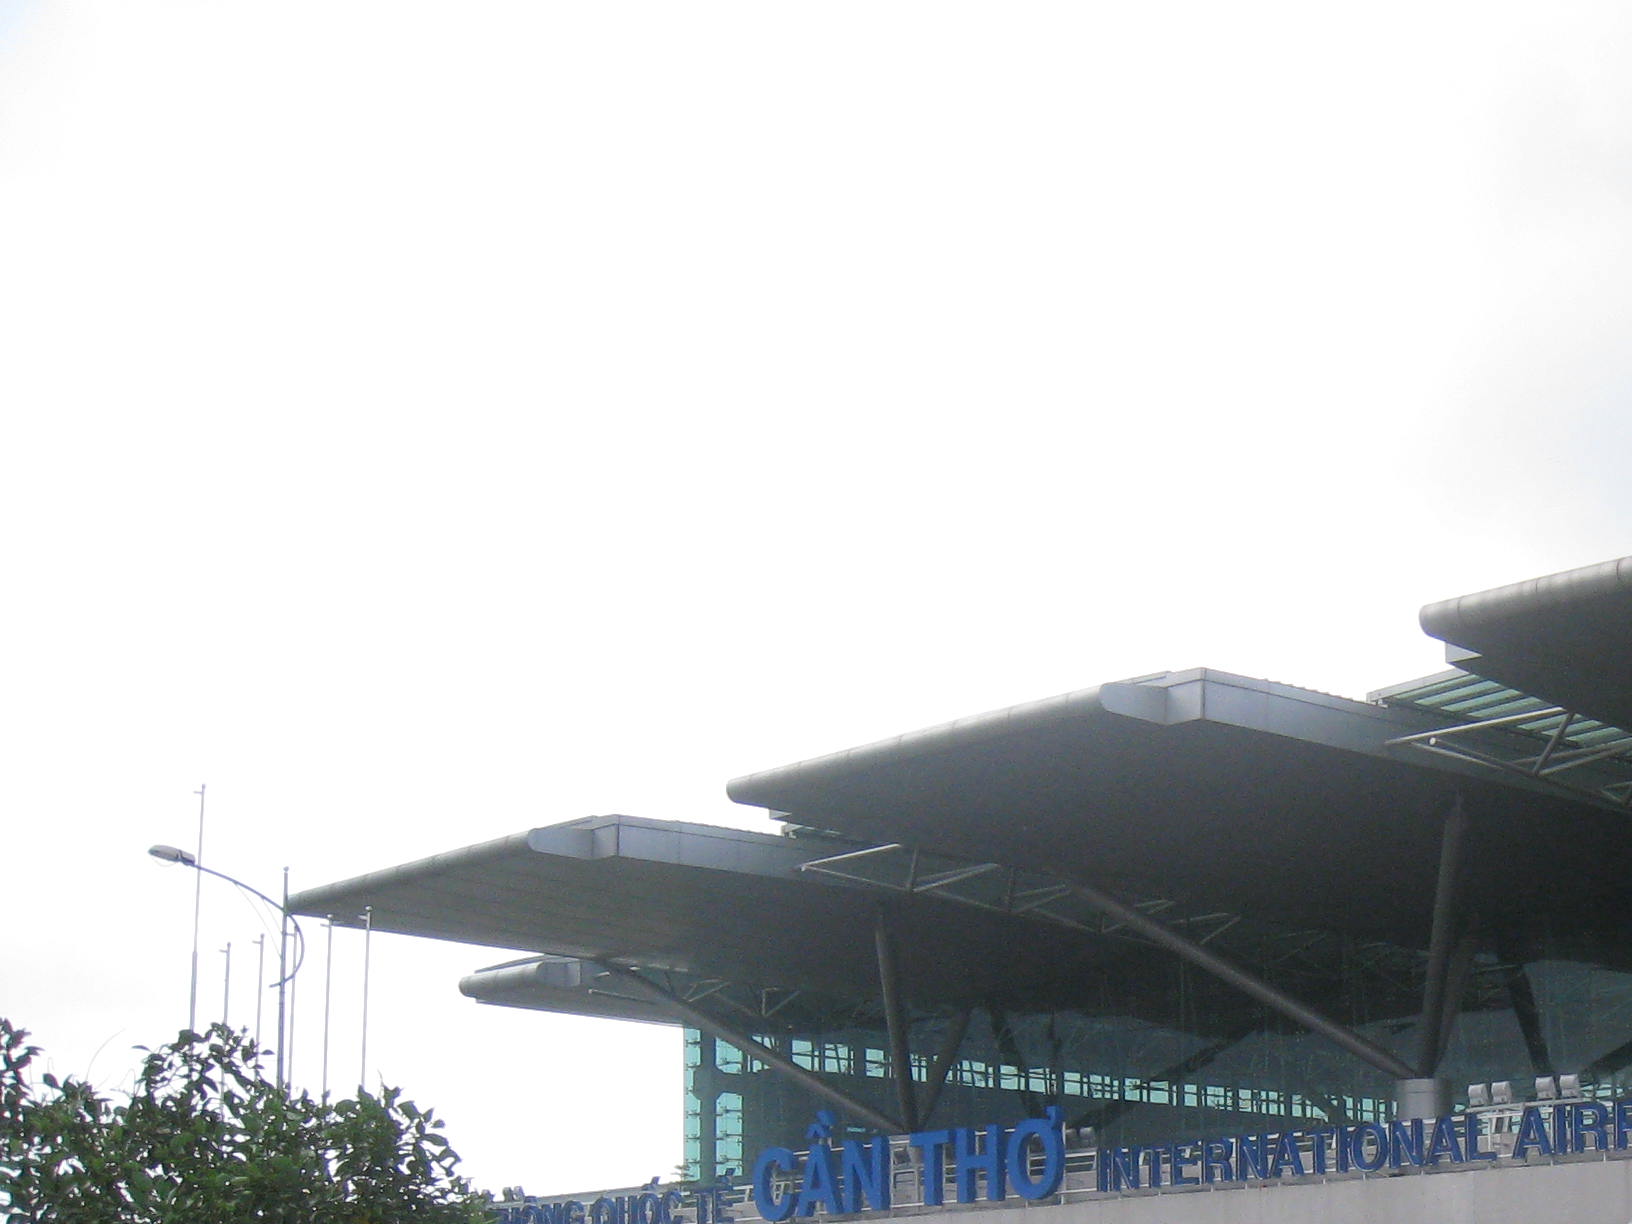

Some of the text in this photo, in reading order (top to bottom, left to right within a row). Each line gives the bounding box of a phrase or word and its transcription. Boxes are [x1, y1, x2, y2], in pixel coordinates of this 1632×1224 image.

[694, 1168, 735, 1224] TẾ
[753, 1110, 890, 1222] CẦN
[910, 1105, 1065, 1206] THƠ
[1097, 1112, 1498, 1193] INTERNATIONAL
